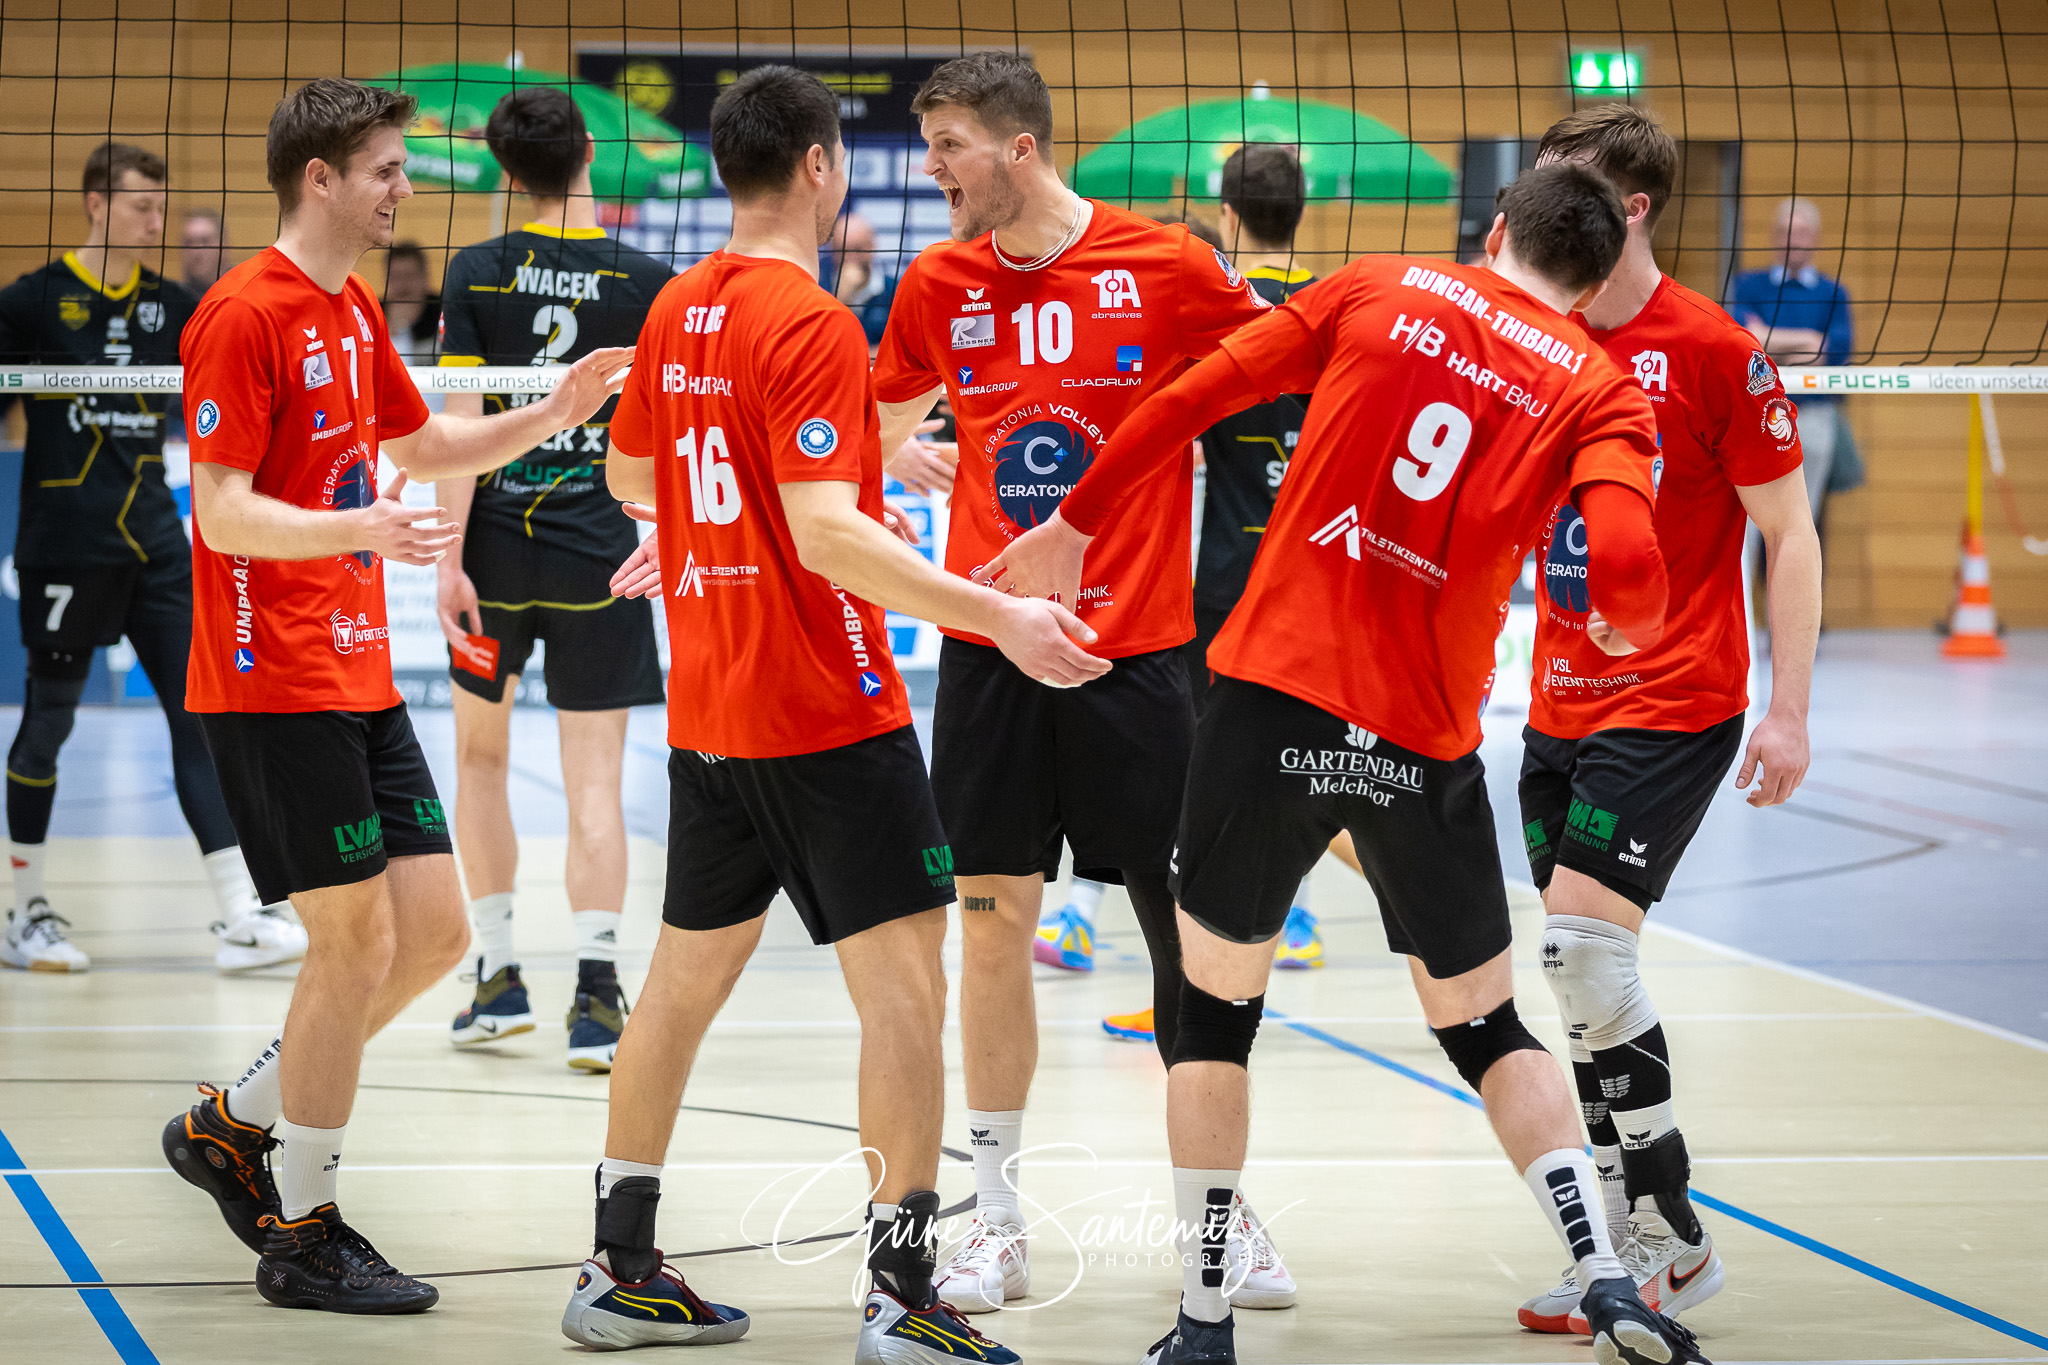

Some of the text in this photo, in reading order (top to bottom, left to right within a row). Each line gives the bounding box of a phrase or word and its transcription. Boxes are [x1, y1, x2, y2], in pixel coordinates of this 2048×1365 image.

[516, 266, 600, 300] WACEK
[961, 302, 992, 312] erima
[1091, 311, 1142, 319] abrasives
[532, 305, 579, 366] 2
[1011, 300, 1073, 366] 10
[43, 373, 93, 388] Ideen
[341, 336, 359, 399] 7
[432, 373, 557, 389] Ideen umsetz
[1061, 378, 1142, 388] CUADRUM
[1828, 375, 1911, 389] FUCHS
[1929, 373, 1976, 389] Ideen
[1048, 403, 1107, 446] VOLLEY
[1392, 401, 1473, 502] 9
[676, 426, 742, 525] 16
[44, 584, 73, 632] 7
[1552, 657, 1572, 673] VSL
[1280, 747, 1424, 788] GARTENBAU
[1309, 776, 1395, 808] Melchior
[1618, 852, 1647, 868] erima
